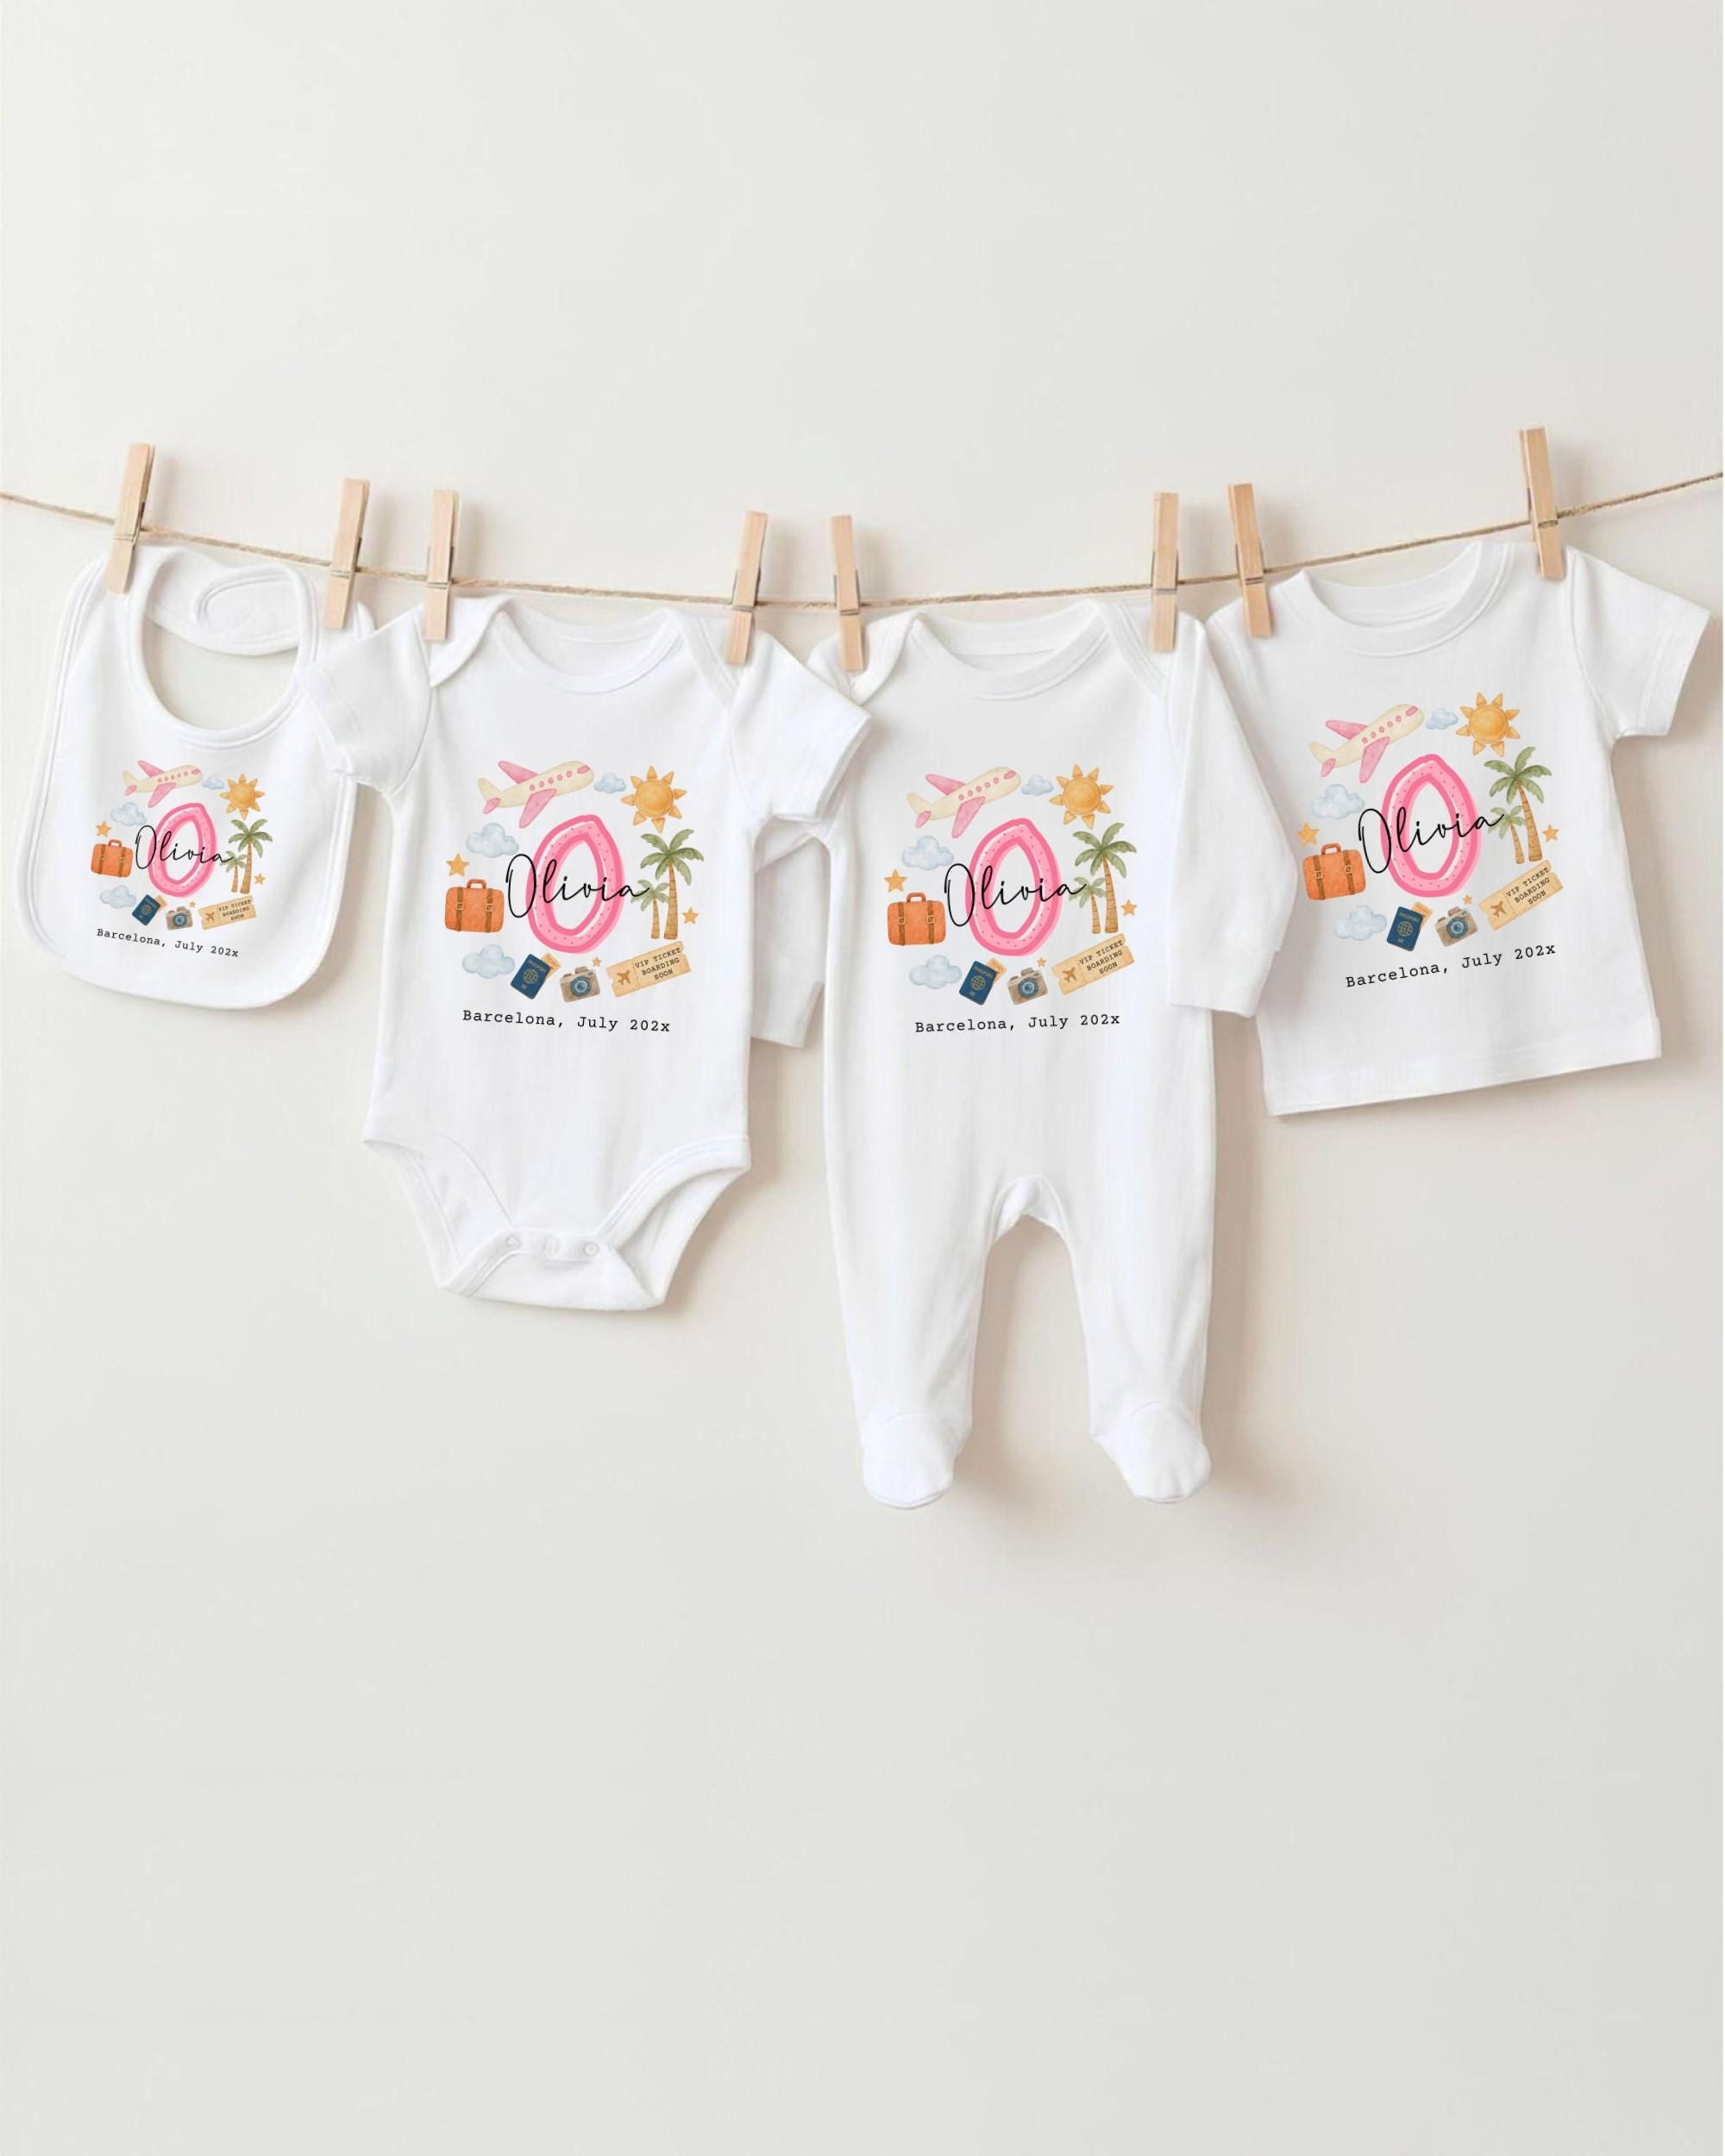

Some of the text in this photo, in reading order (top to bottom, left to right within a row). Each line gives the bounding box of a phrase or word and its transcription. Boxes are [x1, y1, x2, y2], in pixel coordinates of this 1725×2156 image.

[135, 824, 234, 869] Olivia
[1358, 807, 1505, 874] Olivia
[505, 854, 650, 918] Olivia
[1506, 867, 1549, 897] VIP TICKET
[1514, 877, 1550, 903] BOARDING
[944, 863, 1087, 927] Olivia
[1527, 889, 1546, 905] SOON
[96, 928, 239, 957] Barcelona, July 202x
[1079, 940, 1122, 965] VIP TICKET
[635, 947, 681, 968] VIP TICKET
[642, 957, 680, 975] BOARDING
[1086, 950, 1123, 971] BOARDING
[1099, 962, 1118, 975] SOON
[1345, 944, 1557, 988] Barcelona, July 202x
[654, 968, 674, 981] SOON
[461, 1009, 670, 1032] Barcelona, July 202x
[914, 1013, 1120, 1033] Barcelona, July 202x
